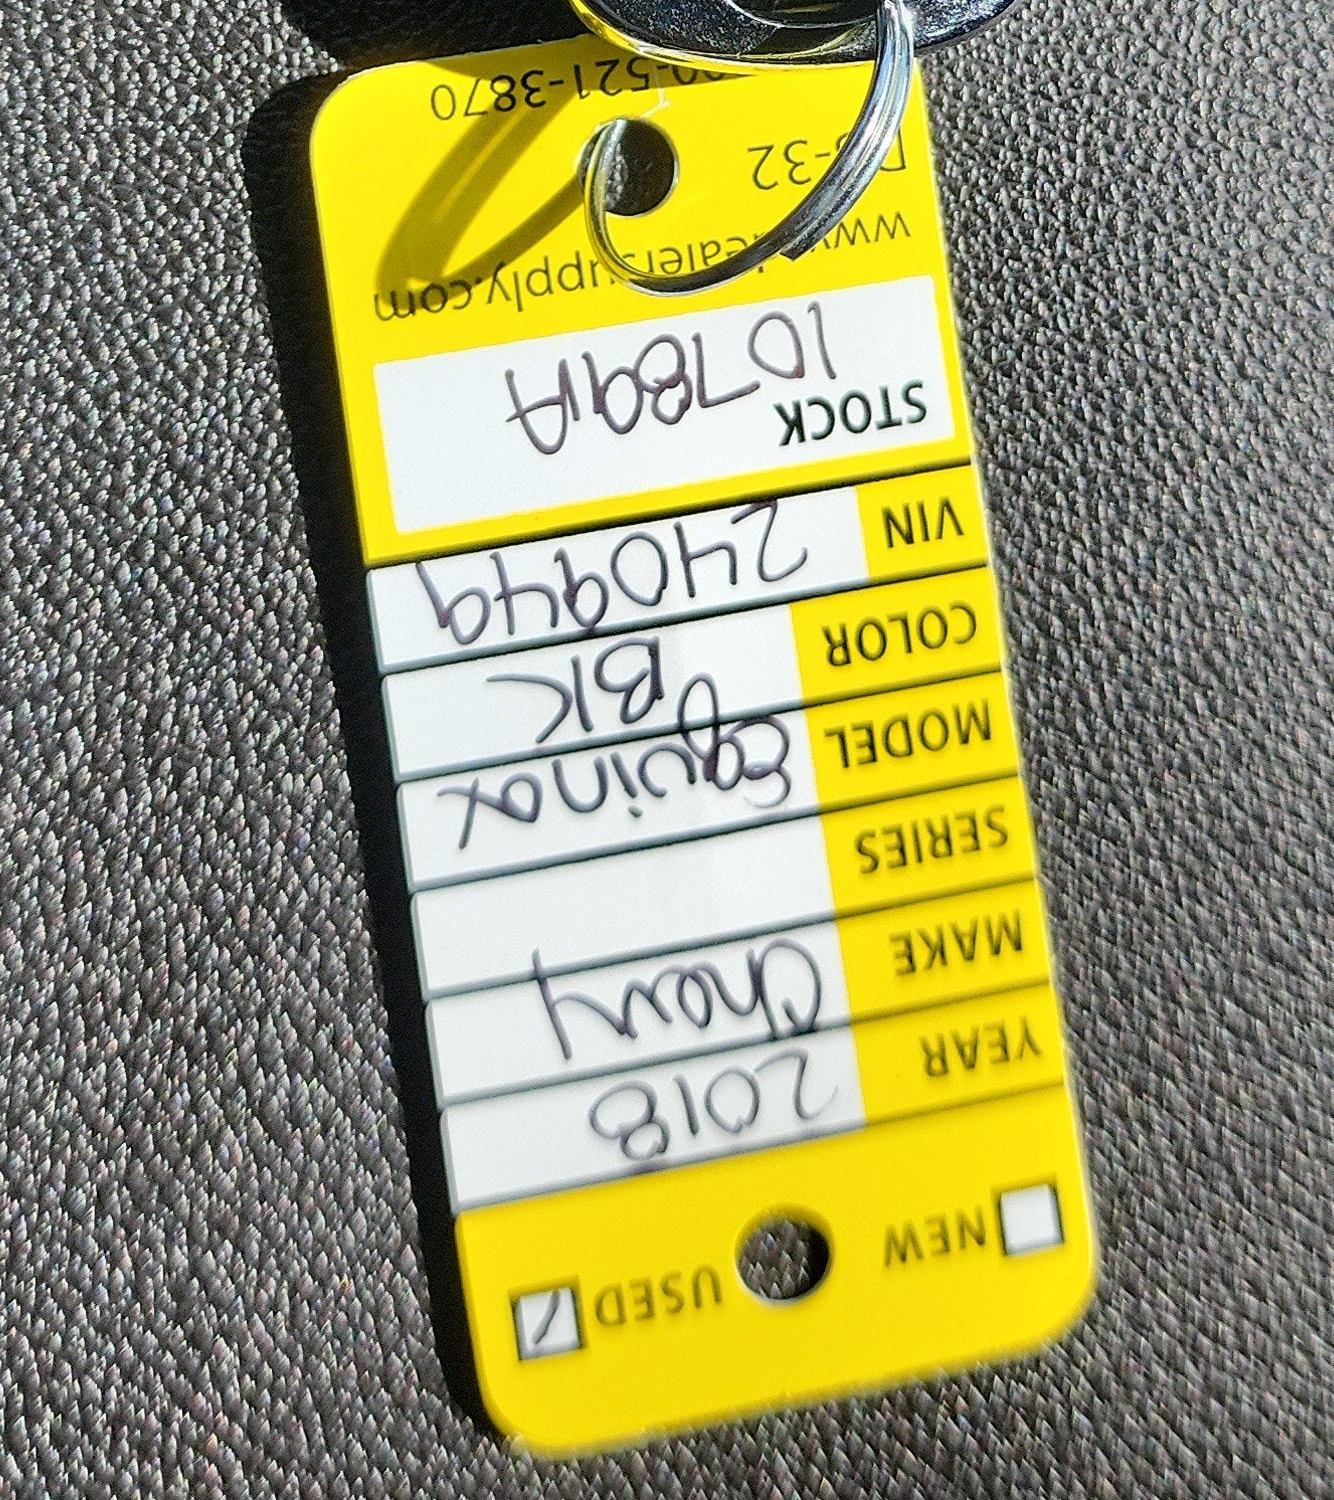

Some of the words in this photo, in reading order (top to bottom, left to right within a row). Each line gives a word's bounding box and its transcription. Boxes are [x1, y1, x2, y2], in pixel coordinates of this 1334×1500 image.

[746, 129, 907, 191] D-32
[779, 379, 929, 447] STOCK
[884, 496, 965, 550] VIN
[415, 501, 808, 645] 240949
[824, 603, 978, 668] COLOR
[486, 635, 665, 744] BK
[437, 672, 791, 850] Equinox
[824, 698, 994, 771] MODEL
[854, 805, 1010, 875] SERIES
[893, 909, 1025, 977] MAKE
[531, 936, 822, 1061] Chevy
[920, 1019, 1045, 1078] YEAR
[589, 1047, 840, 1160] 2018
[883, 1204, 987, 1268] NEW
[595, 1265, 724, 1328] USED
